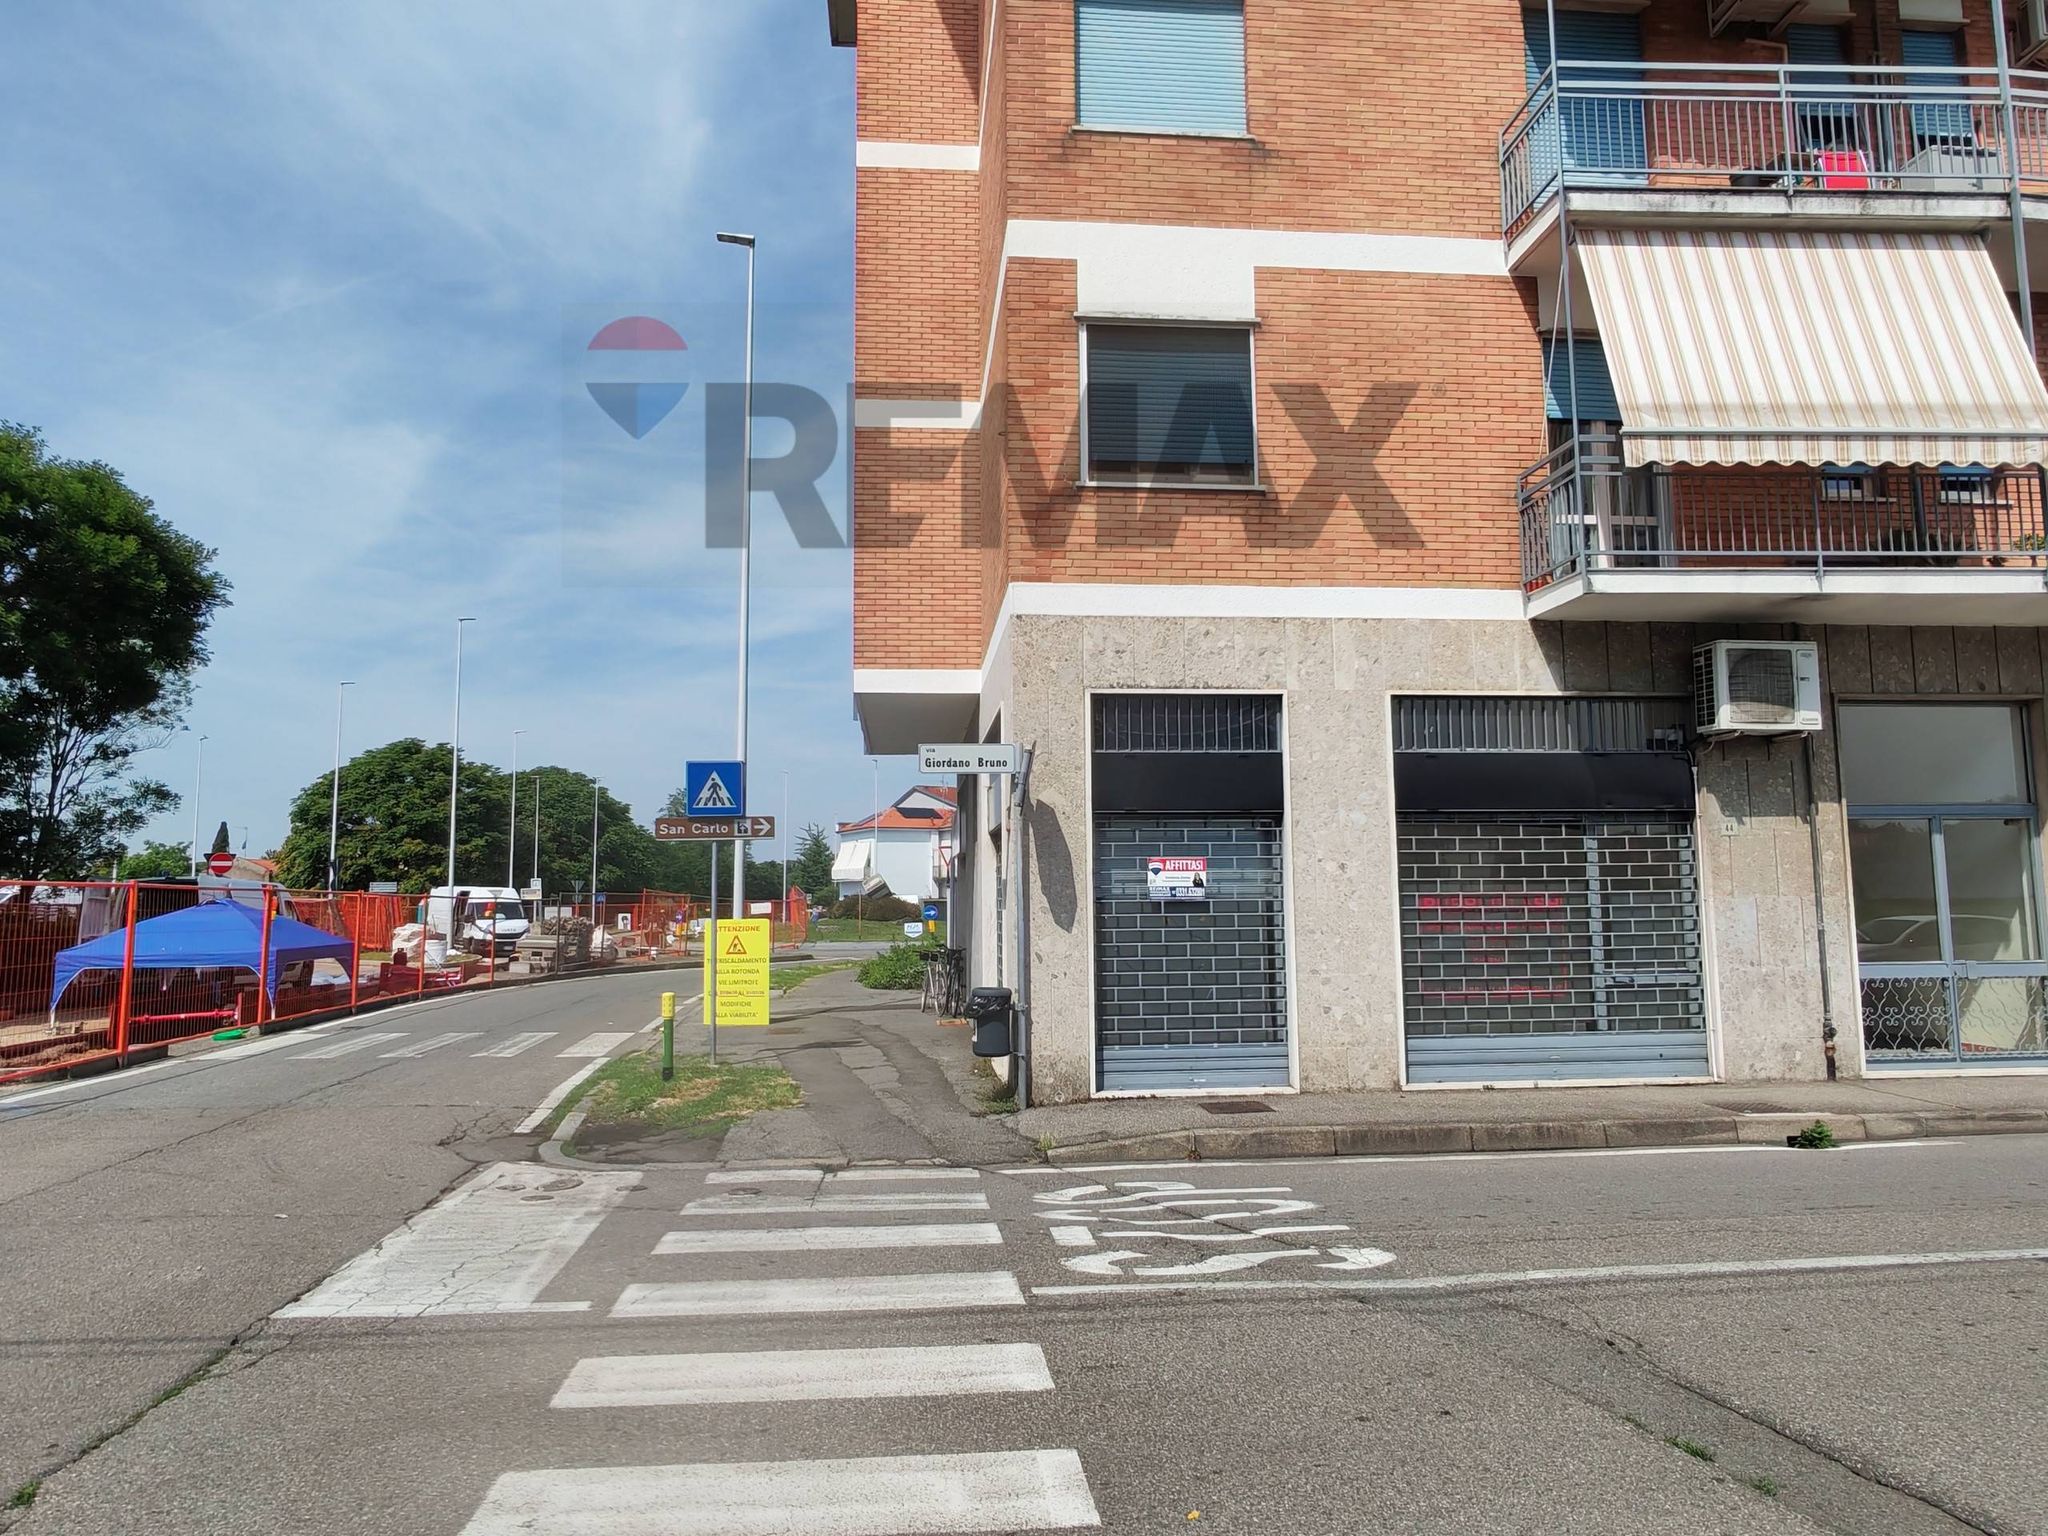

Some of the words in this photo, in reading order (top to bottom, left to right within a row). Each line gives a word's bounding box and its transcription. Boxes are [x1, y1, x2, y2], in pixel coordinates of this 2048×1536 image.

[925, 757, 970, 768] Giordano
[978, 757, 1008, 768] Bruno
[659, 823, 686, 835] San
[691, 823, 729, 834] Carlo
[1165, 859, 1204, 871] AFFITTASI
